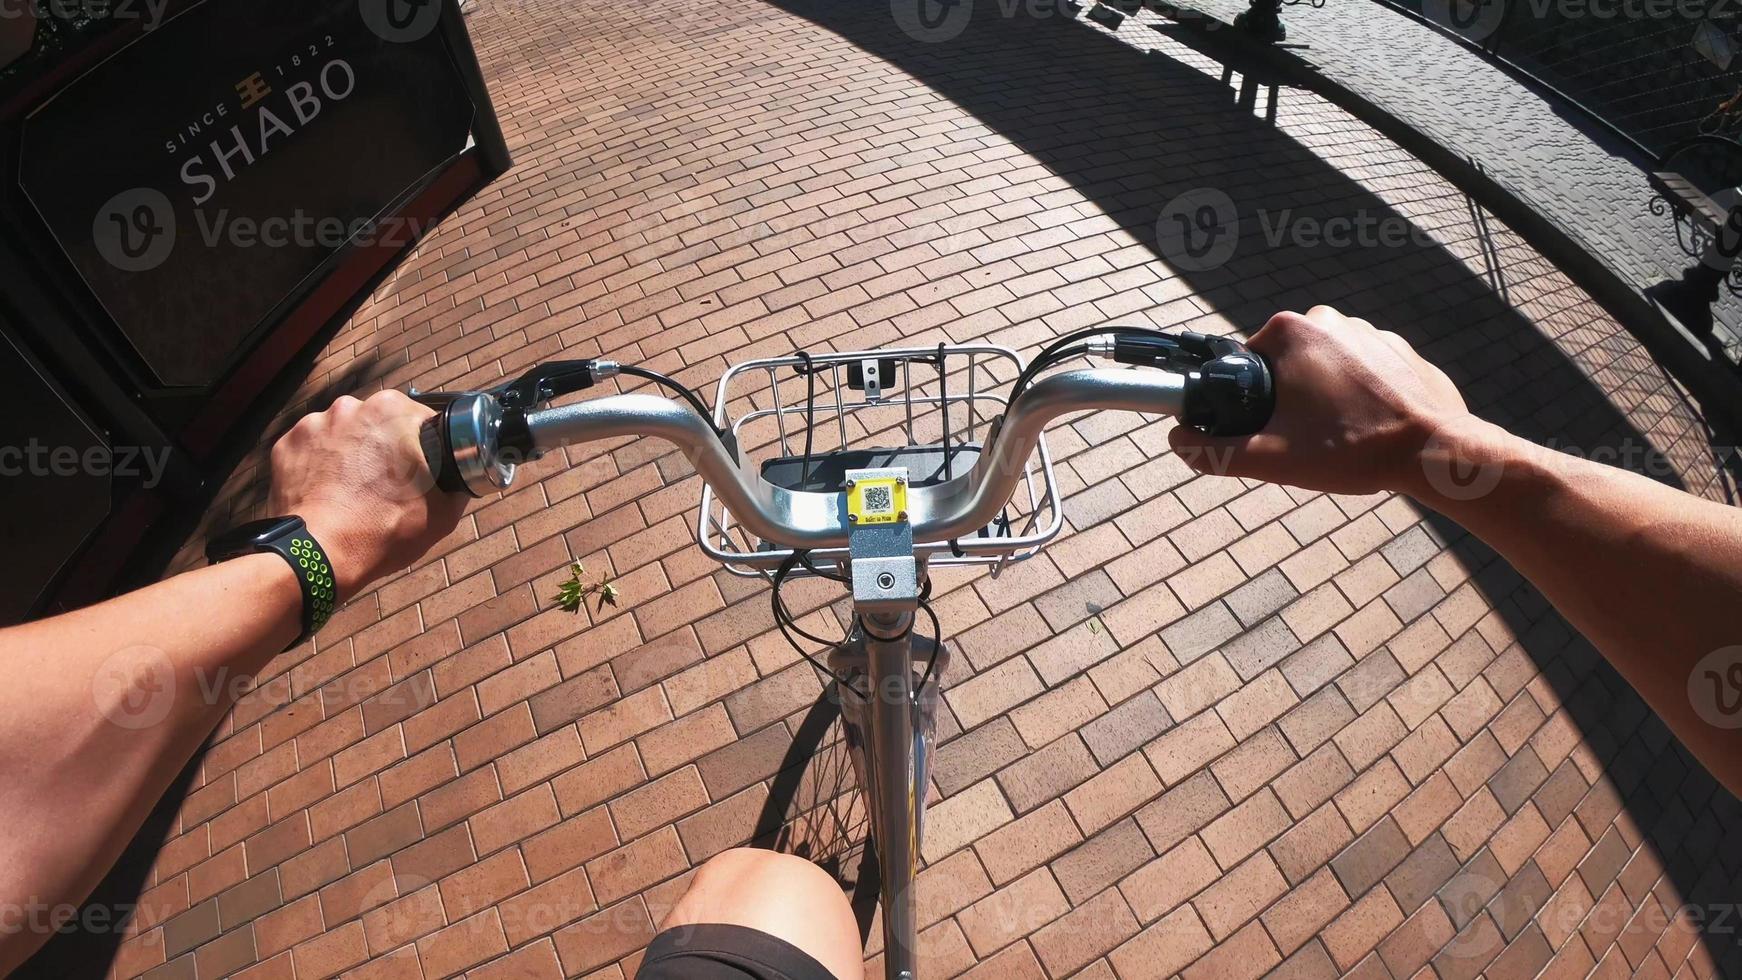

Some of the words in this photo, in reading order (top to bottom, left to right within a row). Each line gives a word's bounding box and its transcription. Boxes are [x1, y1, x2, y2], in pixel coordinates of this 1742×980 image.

[165, 102, 229, 154] SINCE
[274, 34, 335, 77] 1822
[179, 58, 356, 206] SHABO
